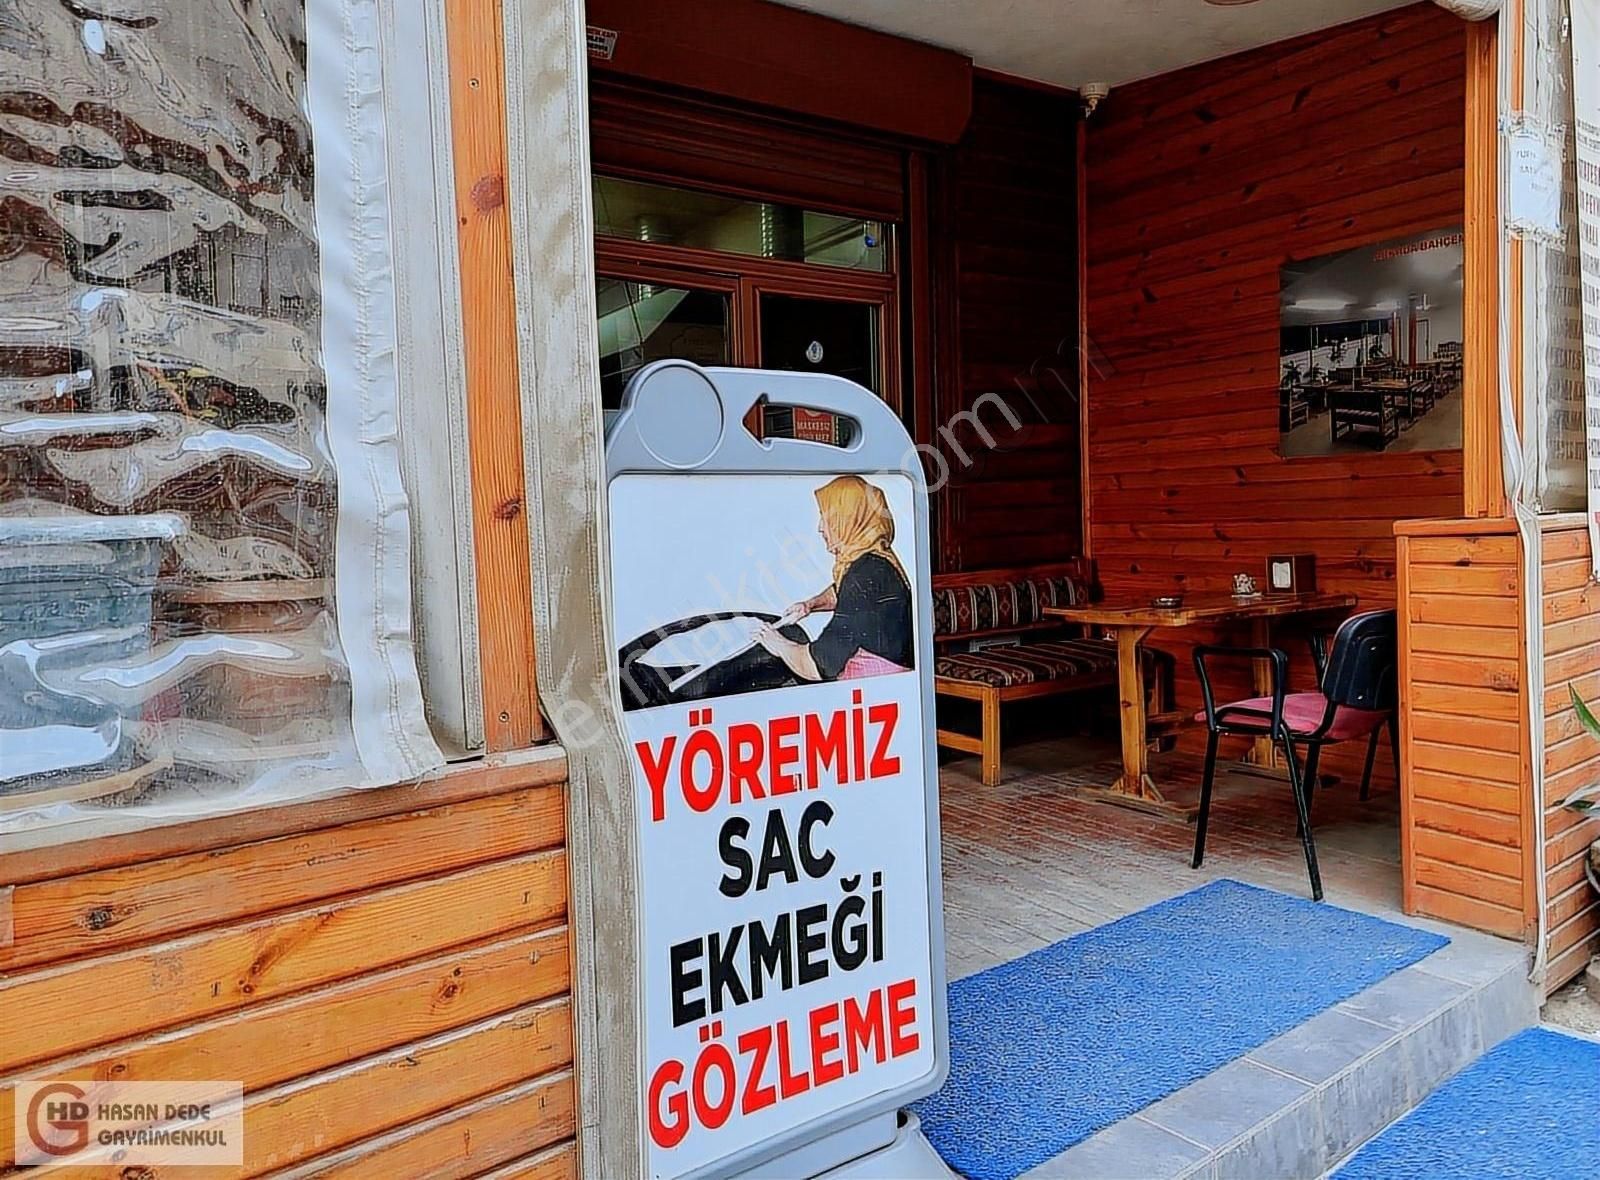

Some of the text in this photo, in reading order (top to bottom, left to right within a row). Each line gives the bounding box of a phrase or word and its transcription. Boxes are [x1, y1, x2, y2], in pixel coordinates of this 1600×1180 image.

[635, 688, 902, 822] YÖREMİZ
[718, 799, 836, 898] SAC
[670, 870, 884, 1028] EKMEĞİ
[647, 978, 920, 1150] GÖZLEME
